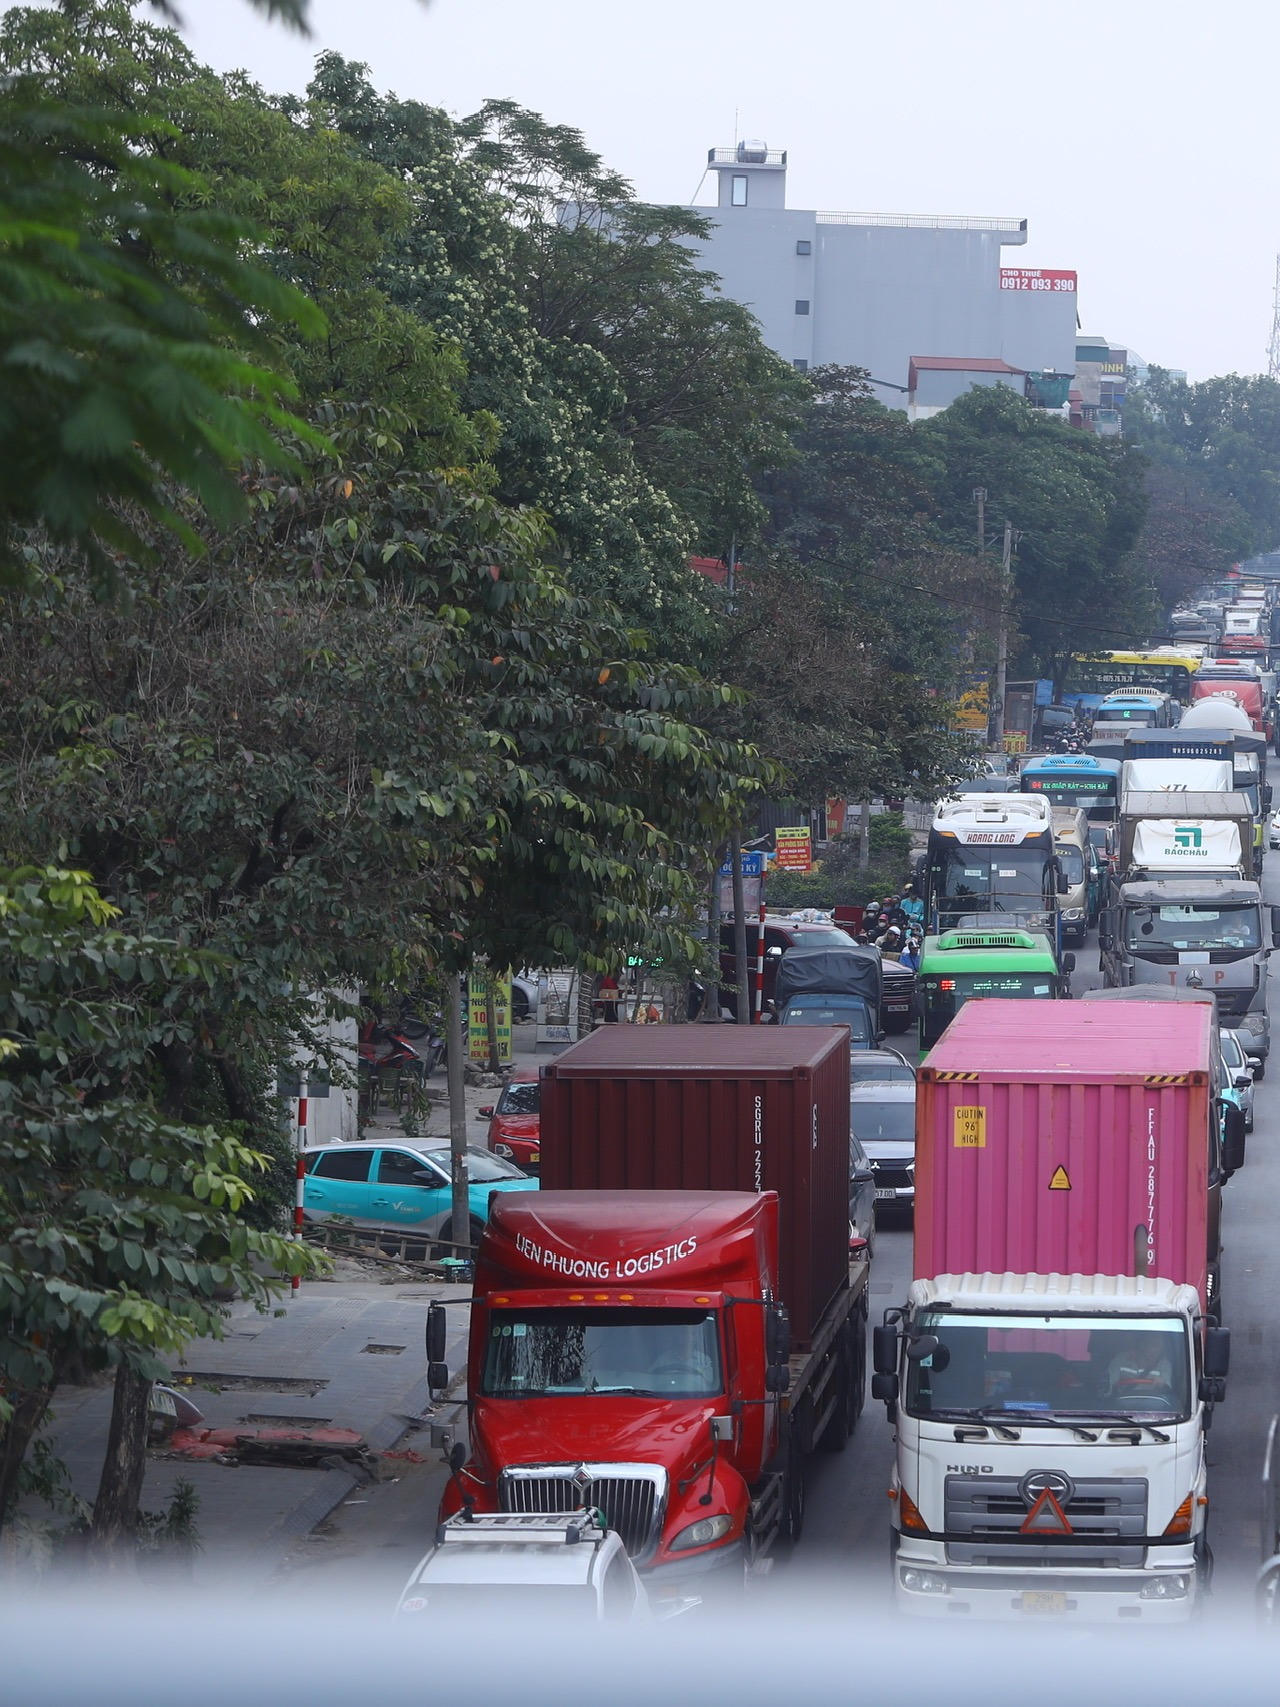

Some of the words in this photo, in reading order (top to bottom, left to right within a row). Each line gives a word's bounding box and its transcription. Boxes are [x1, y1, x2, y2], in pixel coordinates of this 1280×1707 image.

[1001, 269, 1019, 277] CHO
[1001, 277, 1028, 289] 0912
[1031, 278, 1051, 290] 093
[1054, 279, 1075, 291] 390
[994, 833, 1016, 843] LONG
[1168, 971, 1177, 985] T
[1214, 970, 1225, 985] P
[754, 1095, 762, 1145] SGRU
[1147, 1108, 1155, 1161] FFAU
[1146, 1166, 1155, 1245] 287776
[615, 1236, 698, 1278] LOGISTICS
[946, 1464, 994, 1475] HINO
